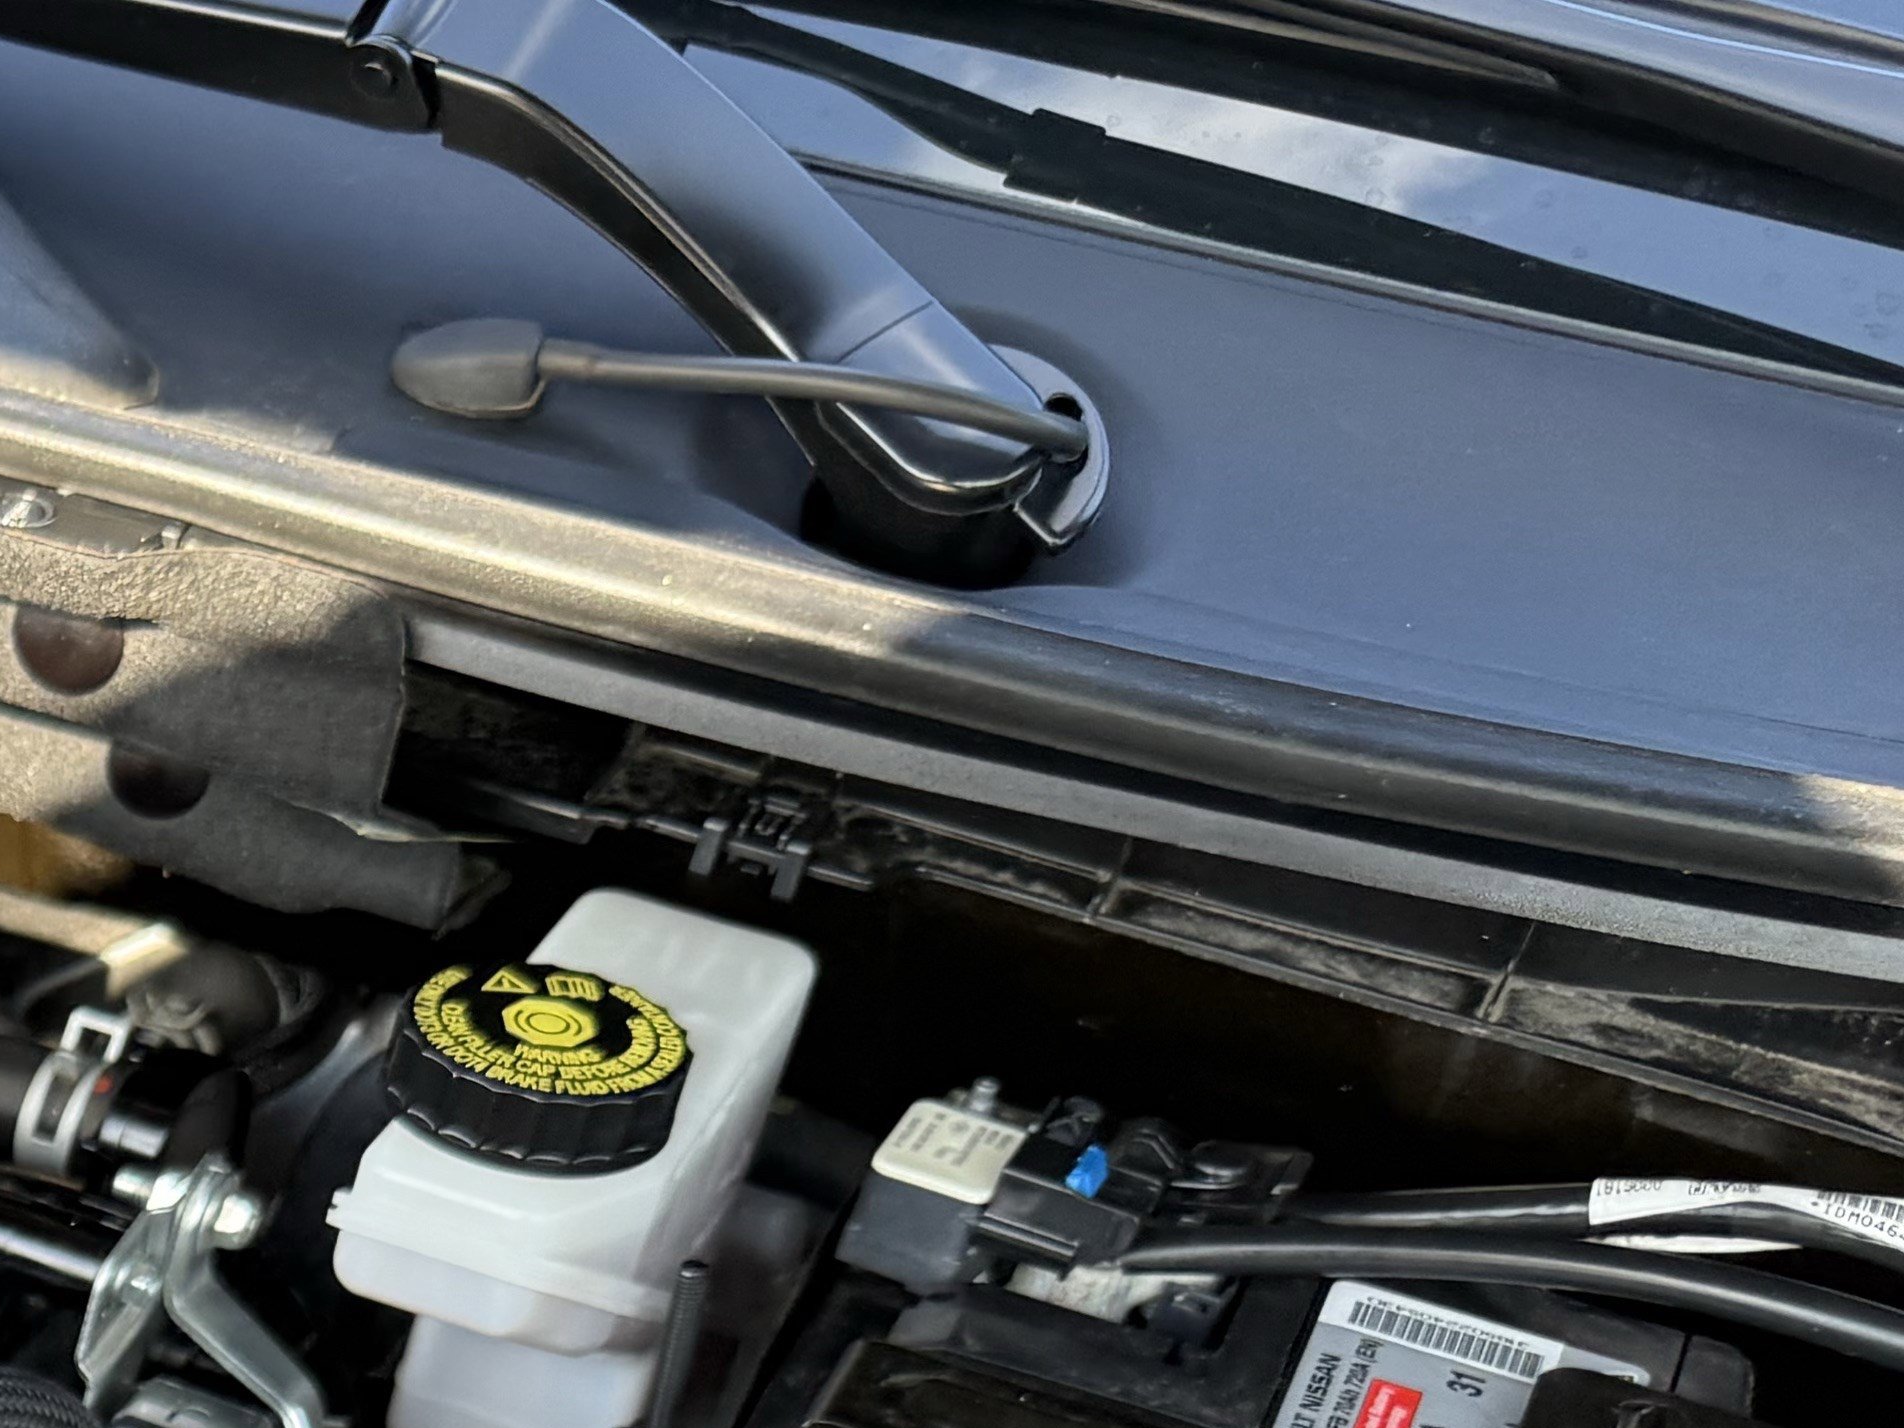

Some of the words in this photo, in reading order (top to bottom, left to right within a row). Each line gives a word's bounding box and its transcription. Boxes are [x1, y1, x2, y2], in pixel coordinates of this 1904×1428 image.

[514, 1044, 604, 1066] WARNING
[487, 1064, 552, 1092] BRAKE
[555, 1077, 610, 1094] FLUID
[516, 1060, 558, 1077] CAP
[558, 1060, 632, 1080] BEFORE
[1299, 1353, 1340, 1411] NISSAN
[1446, 1370, 1485, 1397] 31
